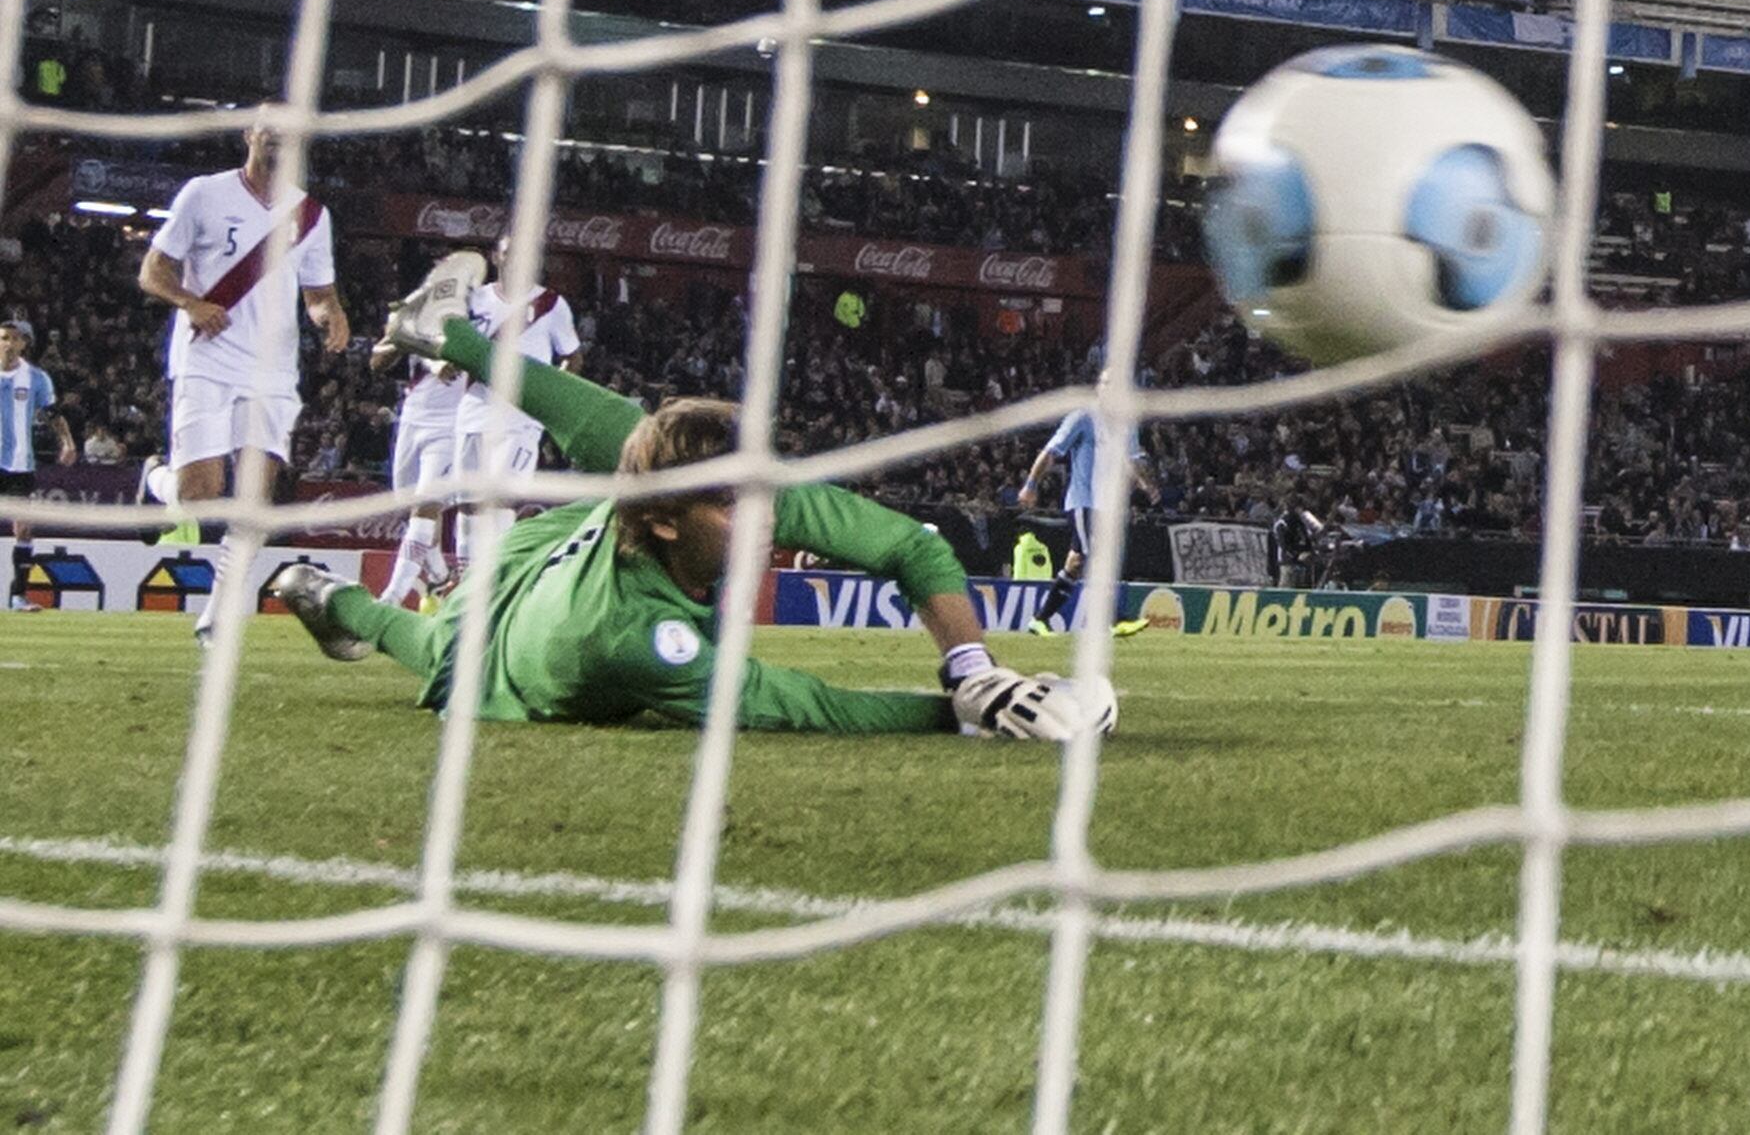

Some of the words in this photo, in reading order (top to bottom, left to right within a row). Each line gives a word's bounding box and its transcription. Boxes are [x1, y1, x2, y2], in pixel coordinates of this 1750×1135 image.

[223, 226, 238, 257] 5
[509, 444, 533, 473] 17
[1201, 590, 1367, 637] Metro
[1508, 603, 1650, 645] CSTAL
